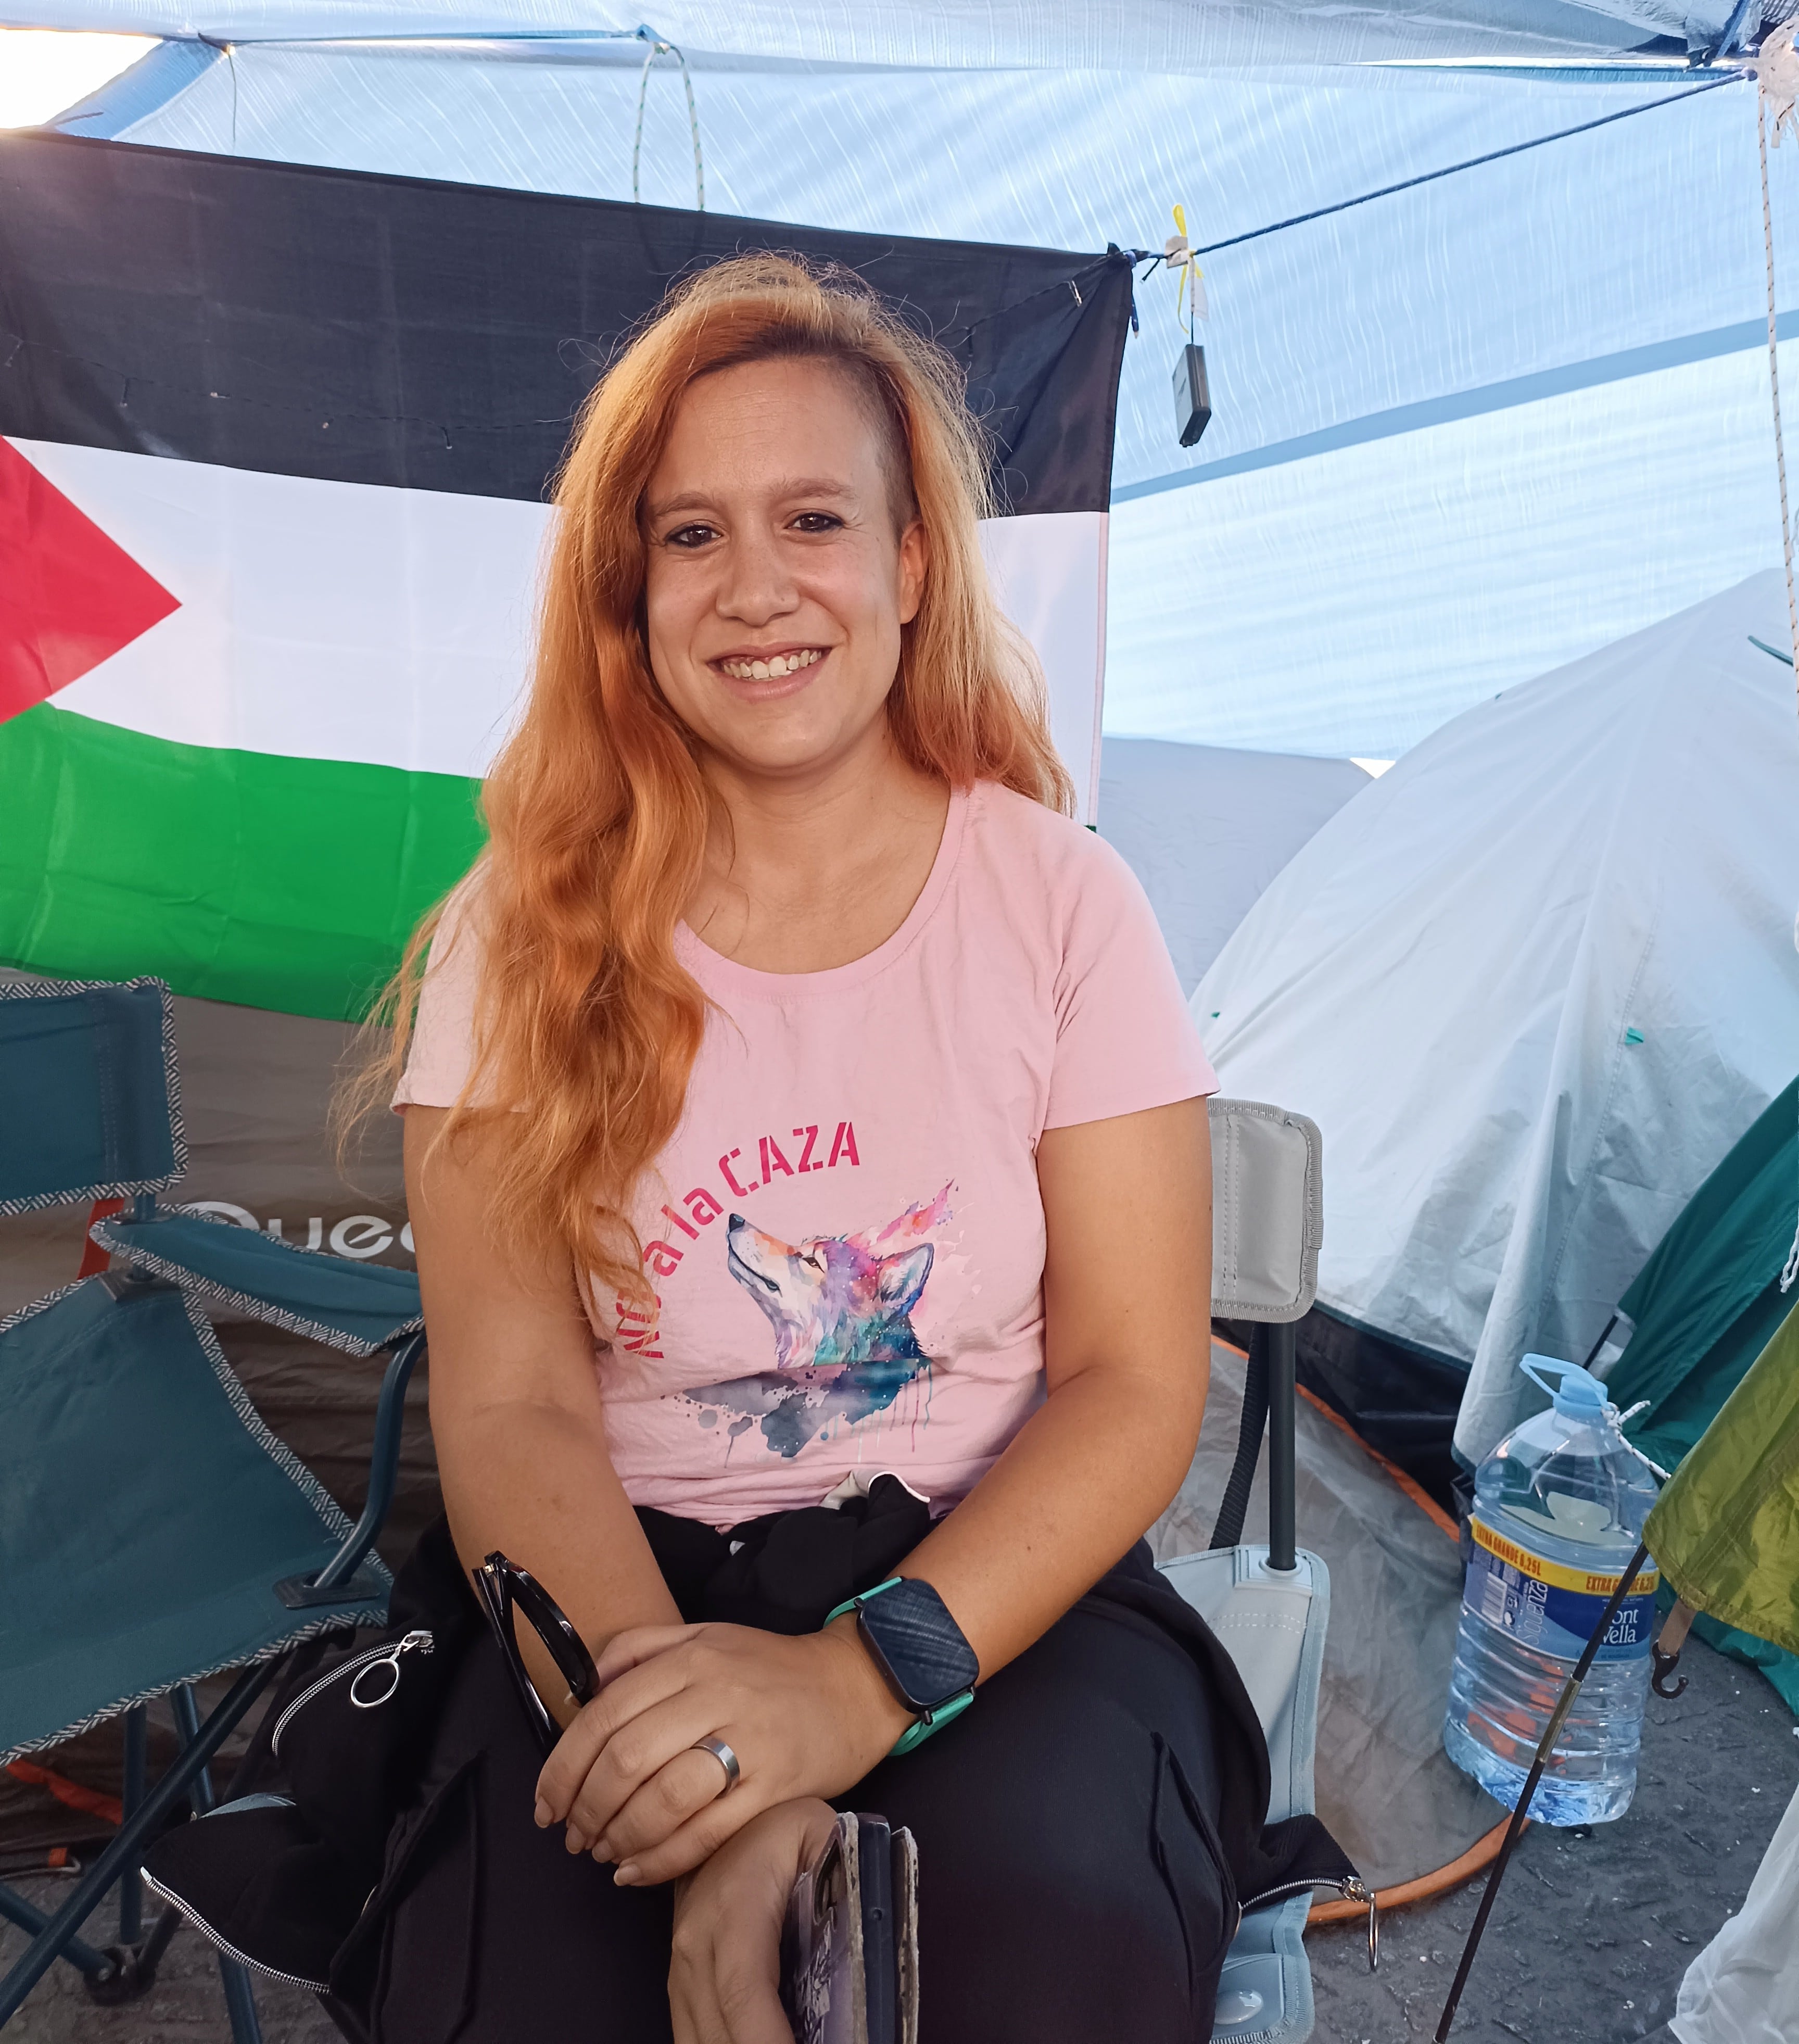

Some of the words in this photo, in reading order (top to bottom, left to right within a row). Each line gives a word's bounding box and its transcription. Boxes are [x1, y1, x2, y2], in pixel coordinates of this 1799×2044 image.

[718, 1121, 860, 1197] CAZA
[183, 1201, 416, 1258] ue
[661, 1188, 724, 1241] la
[642, 1240, 684, 1277] a
[616, 1288, 665, 1359] NO
[1476, 1524, 1493, 1549] EXTRA
[1493, 1536, 1519, 1564] GRANDE
[1586, 1576, 1612, 1592] EXTRA
[1603, 1624, 1637, 1644] Vella
[1604, 1607, 1639, 1624] ont
